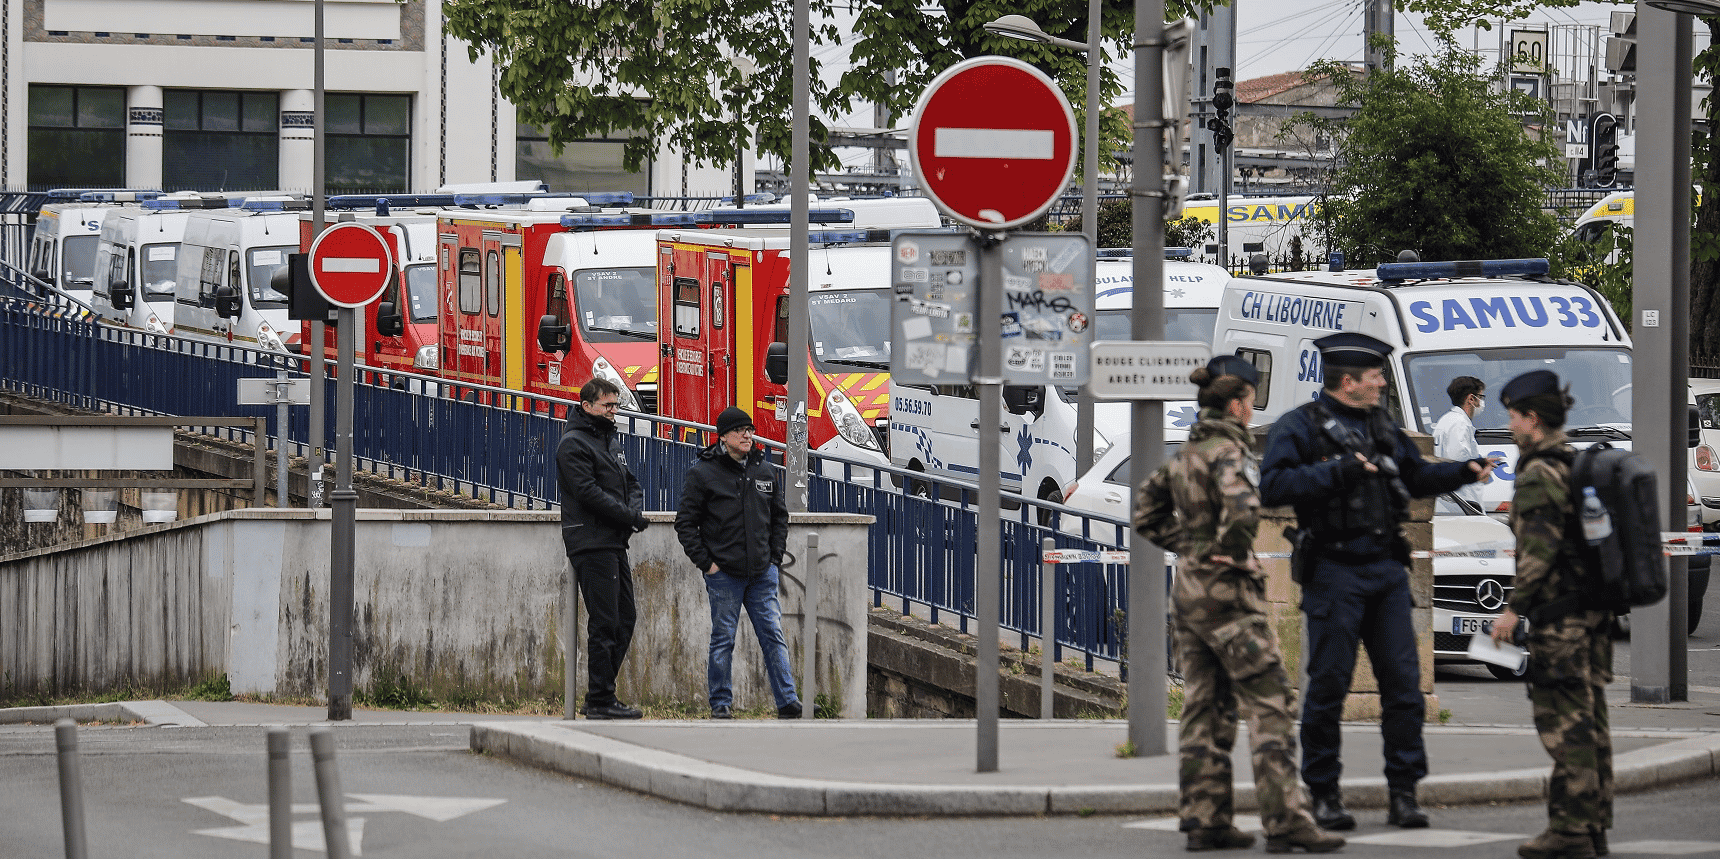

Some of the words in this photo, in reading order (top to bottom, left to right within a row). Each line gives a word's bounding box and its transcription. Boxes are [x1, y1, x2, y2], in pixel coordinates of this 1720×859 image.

[1517, 40, 1542, 63] 60
[1566, 119, 1589, 143] Nf
[1168, 275, 1204, 283] HELP
[1241, 291, 1264, 319] CH
[1266, 294, 1346, 330] LIBOURNE
[1097, 356, 1134, 367] ROUGE
[1140, 357, 1206, 367] CLIGNOTANT
[1108, 372, 1145, 384] ARRÊT
[1151, 375, 1191, 385] ABSOL
